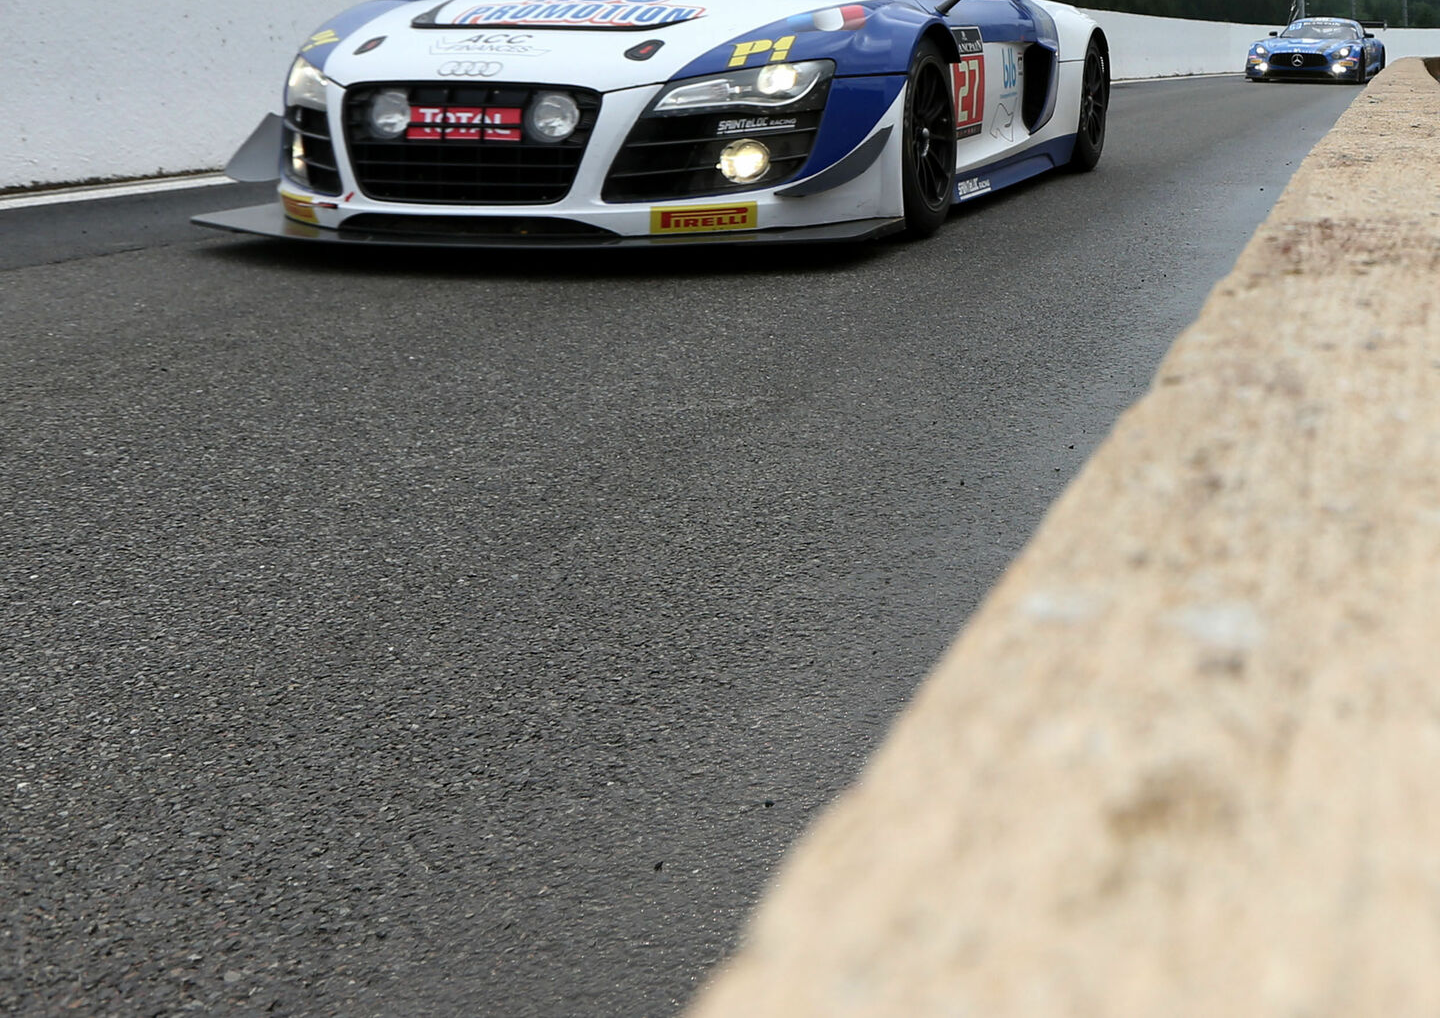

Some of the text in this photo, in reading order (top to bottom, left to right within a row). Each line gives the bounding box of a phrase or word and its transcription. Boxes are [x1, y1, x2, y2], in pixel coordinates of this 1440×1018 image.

[456, 3, 698, 25] PROMOTION
[457, 33, 533, 44] ACC
[727, 35, 797, 68] P1
[958, 59, 980, 123] 27
[660, 206, 748, 229] PIRELLI
